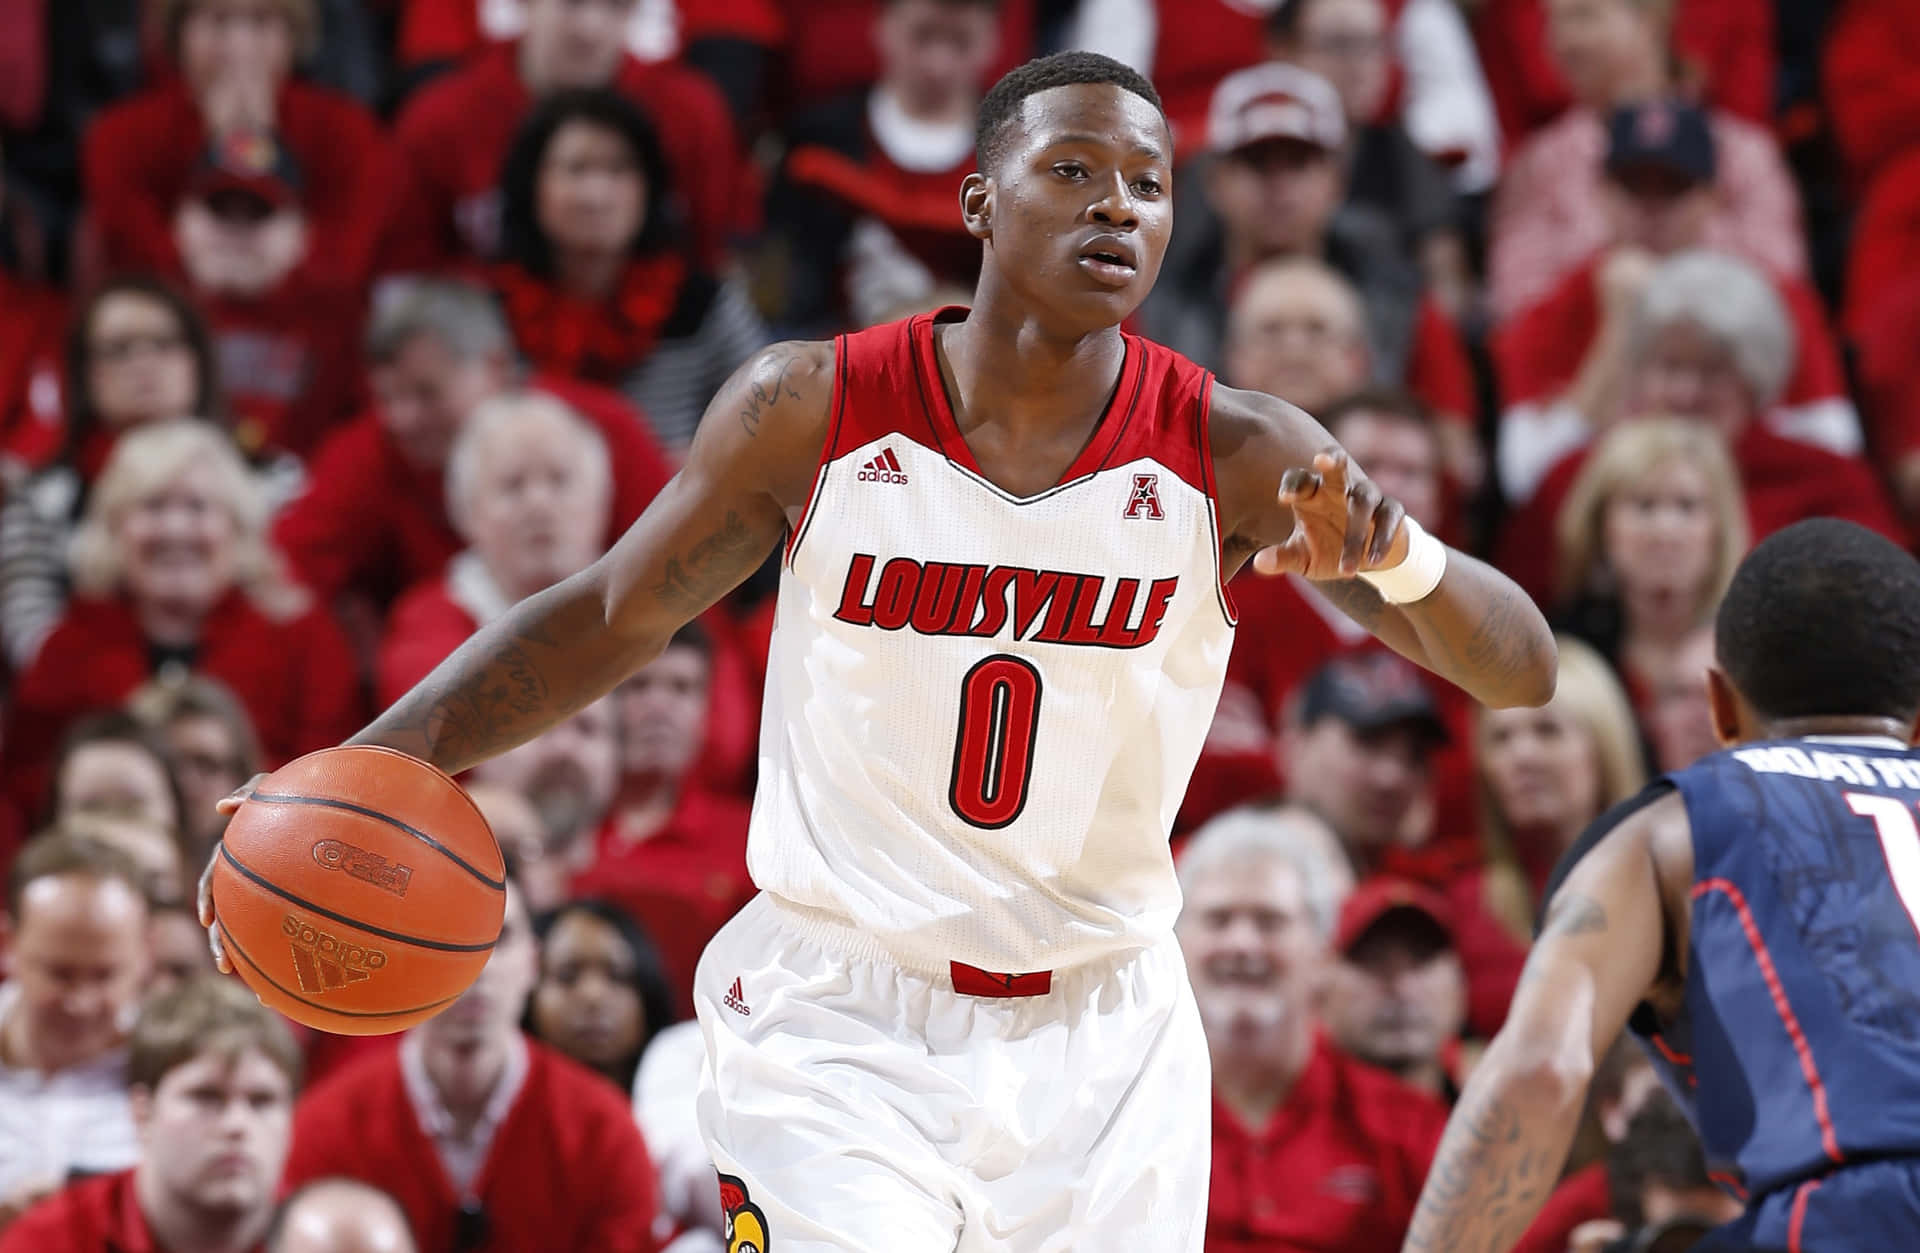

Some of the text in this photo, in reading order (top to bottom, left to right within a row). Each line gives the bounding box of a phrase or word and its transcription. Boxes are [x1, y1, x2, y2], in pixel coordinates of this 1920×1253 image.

[857, 470, 909, 485] adidas
[832, 553, 1179, 649] LOUISVILLE
[948, 653, 1043, 830] 0
[283, 914, 387, 969] adidas
